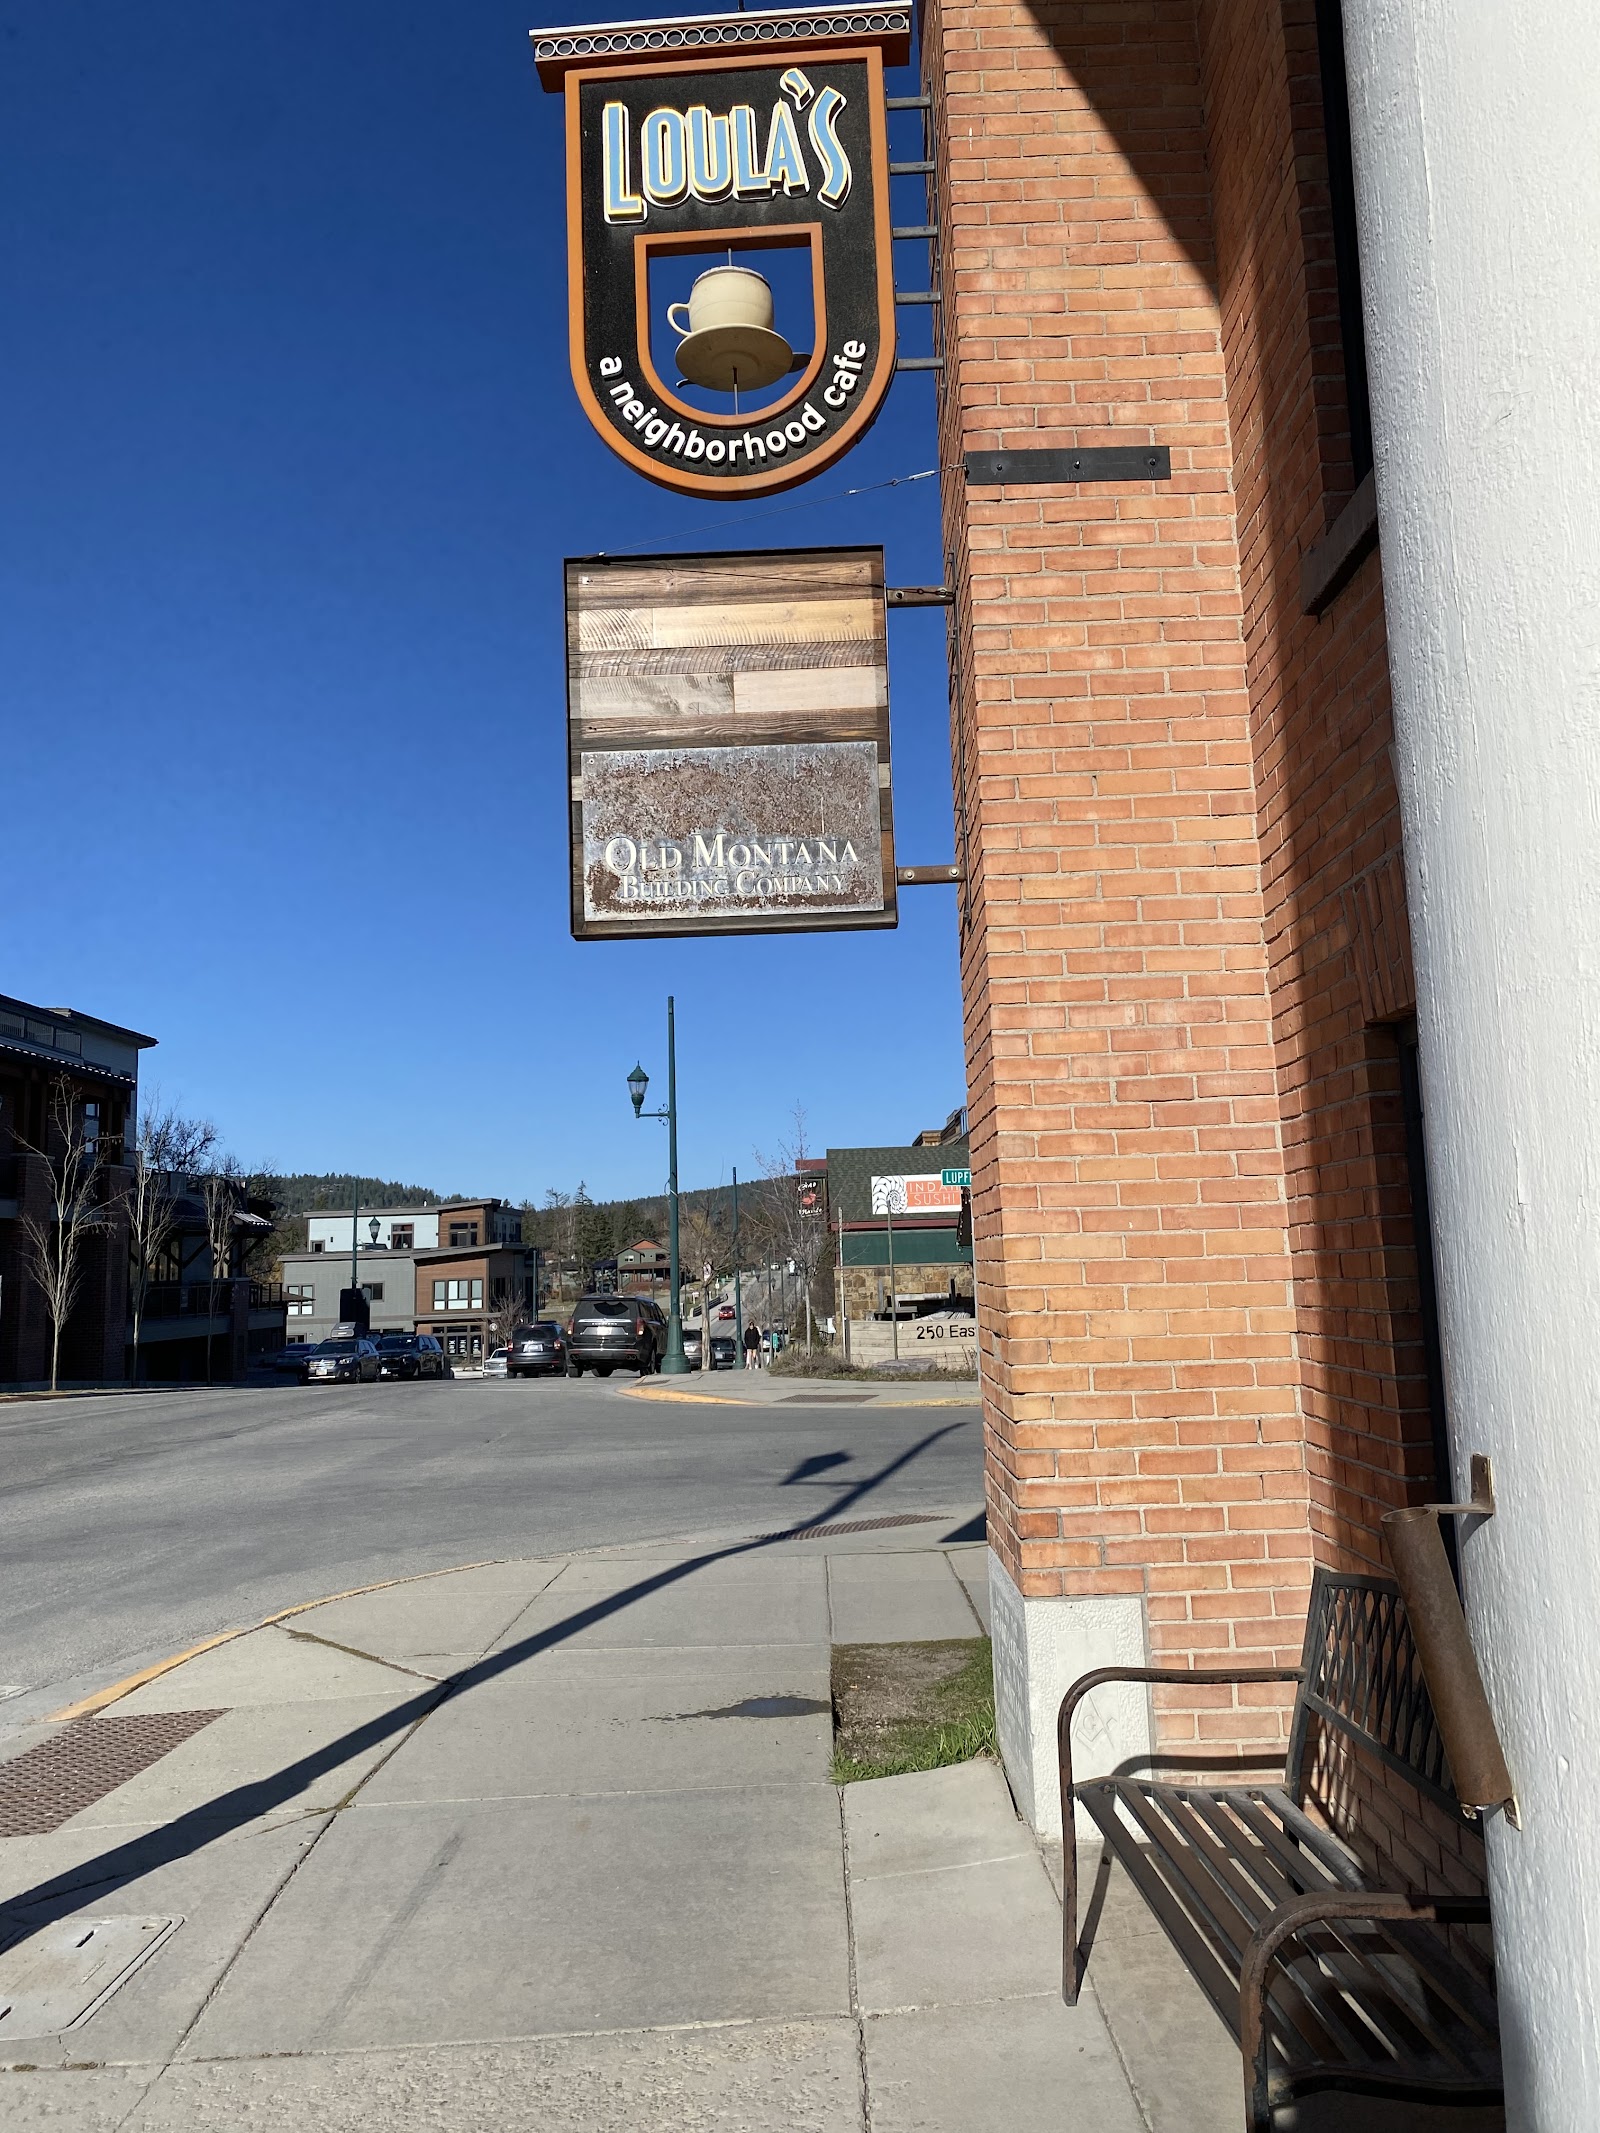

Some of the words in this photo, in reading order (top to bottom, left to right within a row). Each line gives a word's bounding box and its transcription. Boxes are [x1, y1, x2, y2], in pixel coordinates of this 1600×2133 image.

[603, 68, 852, 224] LOULA'S
[600, 356, 622, 376] a
[823, 339, 867, 407] cafe
[609, 378, 826, 464] neighborhood
[604, 836, 682, 872] OLD
[691, 831, 859, 869] MONTANA
[620, 874, 729, 899] BUILDING
[736, 870, 847, 894] COMPANY
[914, 1193, 955, 1206] SUSHI
[917, 1325, 944, 1340] 250
[949, 1324, 976, 1338] Eas
